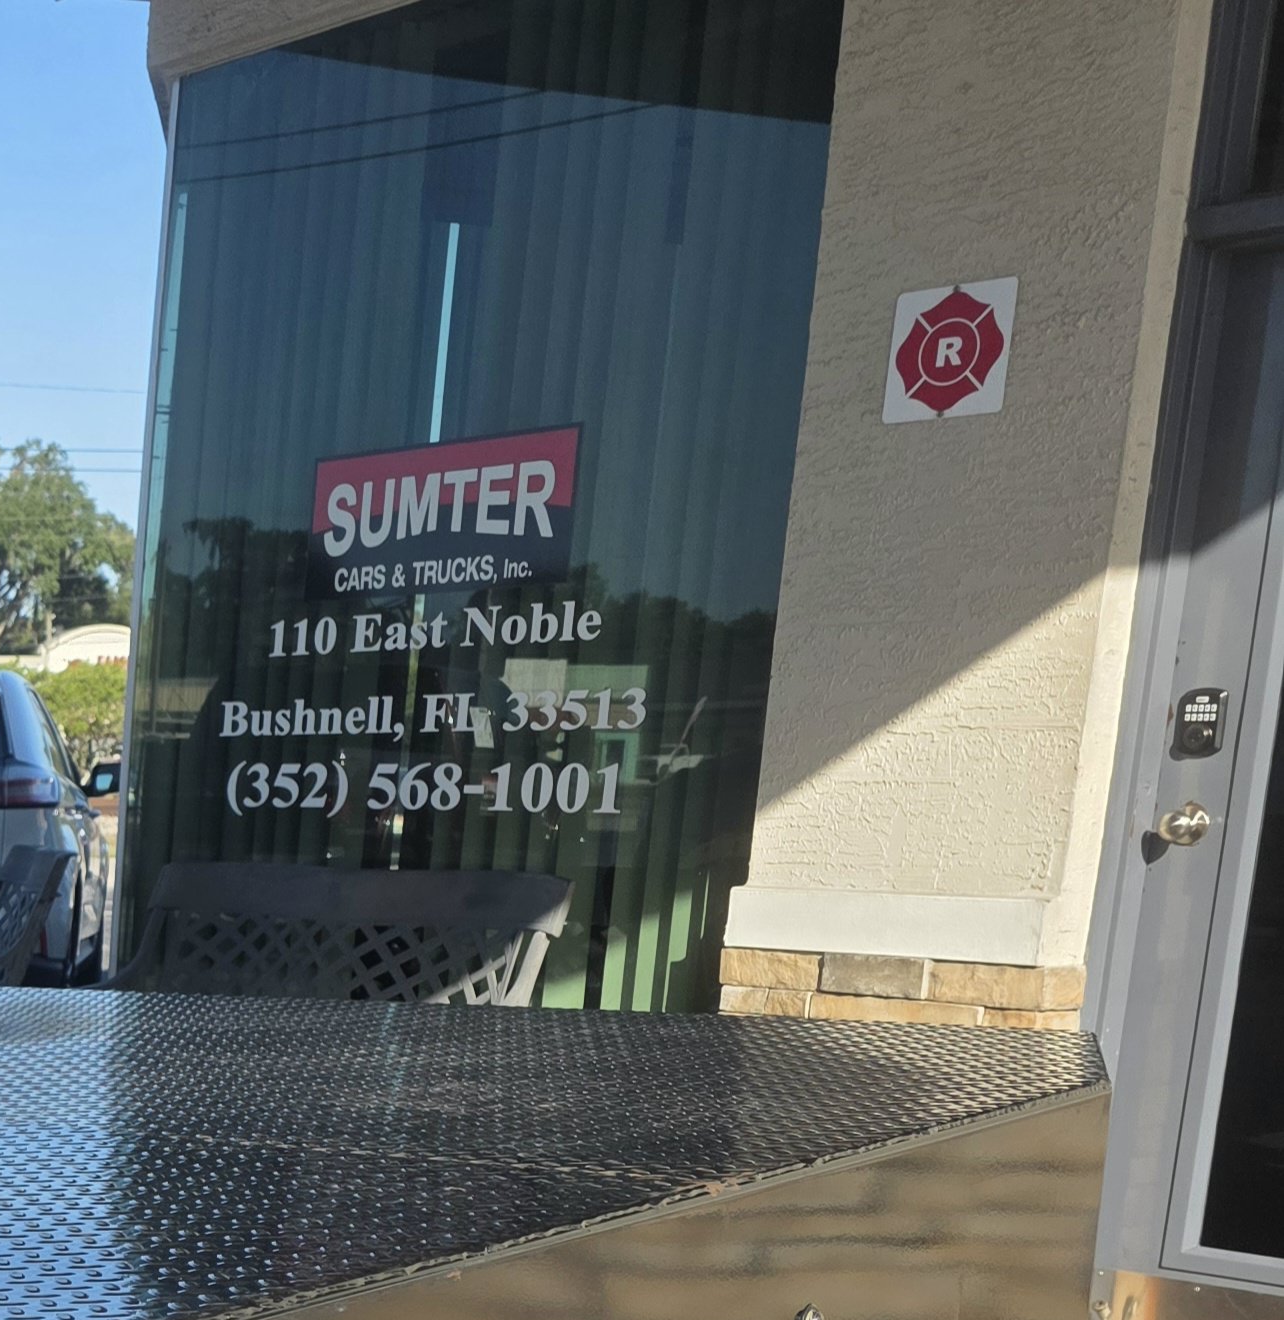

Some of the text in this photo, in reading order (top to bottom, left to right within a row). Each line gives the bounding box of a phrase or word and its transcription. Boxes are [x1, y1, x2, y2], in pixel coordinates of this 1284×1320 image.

[935, 336, 963, 368] R
[323, 459, 556, 558] SUMTER
[334, 554, 533, 592] CARS & TRUCKS, Inc.
[268, 600, 603, 658] 110 East Noble
[219, 686, 648, 741] Bushnell, FL 33513
[226, 760, 622, 818] (352) 568-1001
